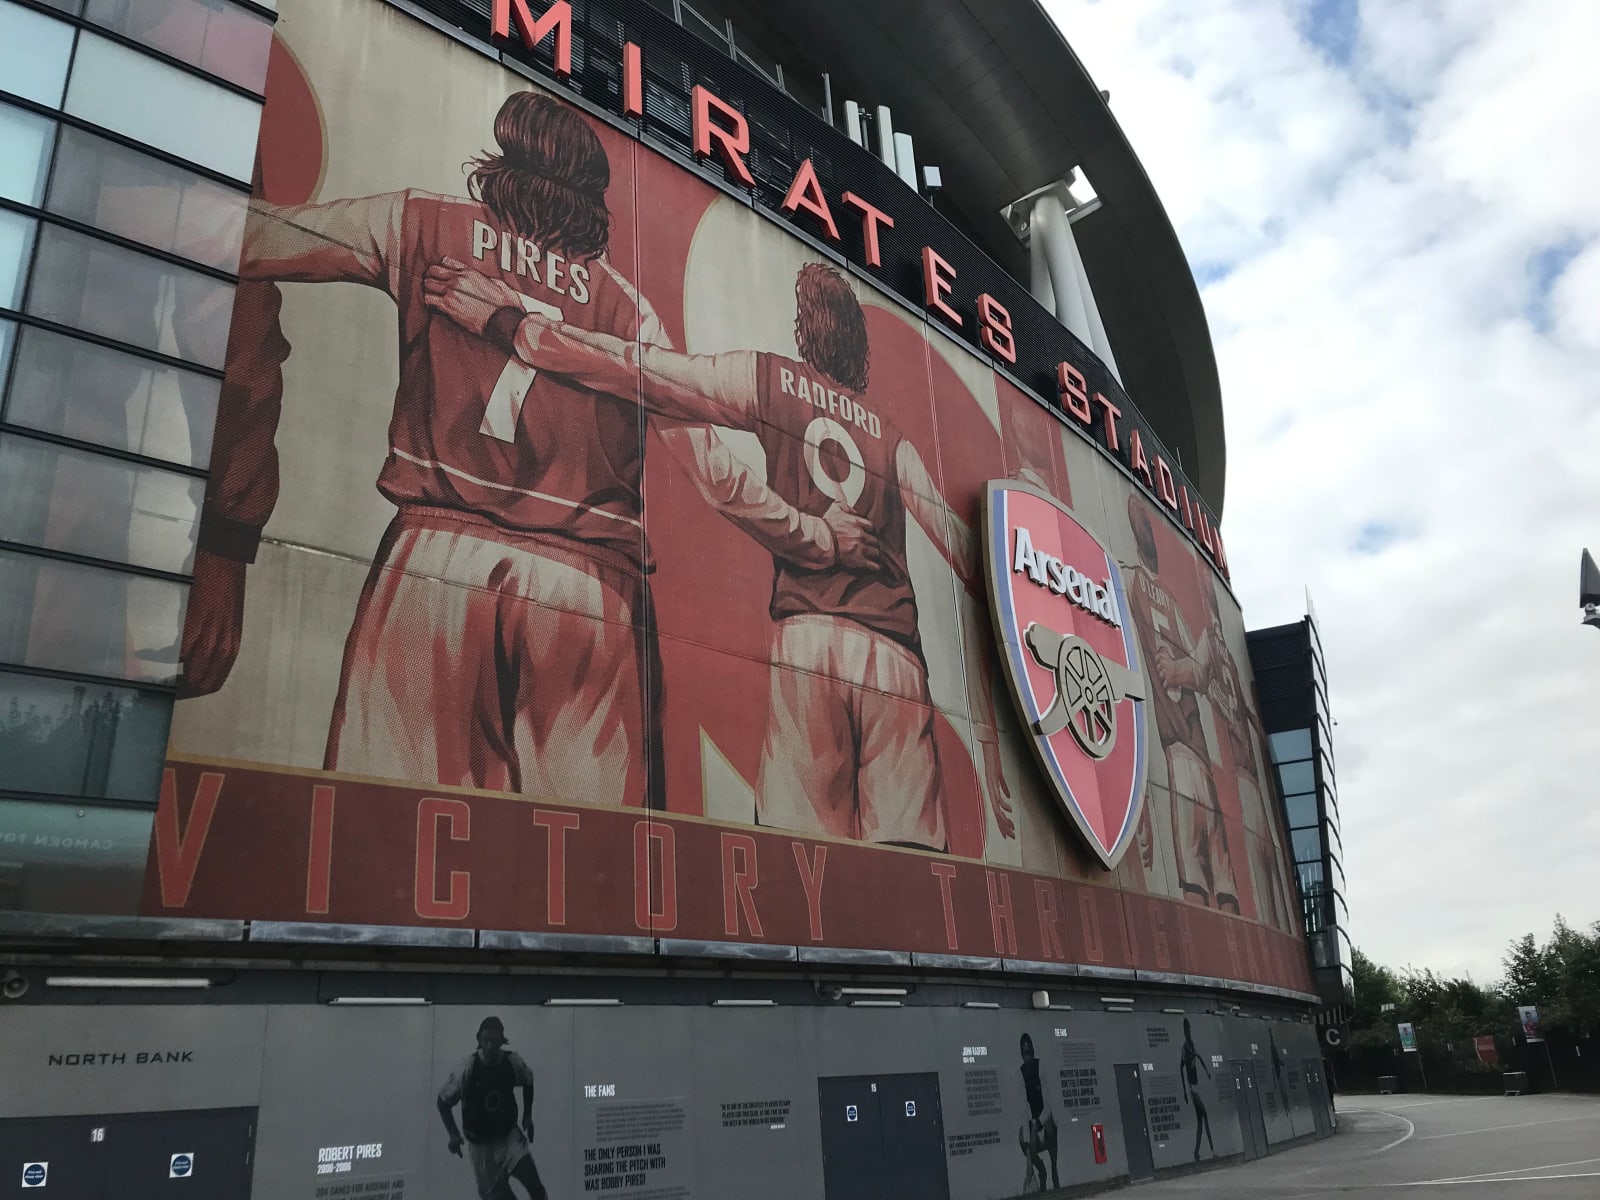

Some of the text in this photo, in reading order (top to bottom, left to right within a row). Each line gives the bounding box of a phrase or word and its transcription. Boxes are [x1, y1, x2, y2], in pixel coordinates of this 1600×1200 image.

[472, 219, 590, 304] PIRES
[780, 367, 882, 439] RADFORD
[1057, 361, 1230, 580] STADIUM
[1014, 526, 1123, 628] Arsenal
[154, 767, 828, 941] VICTORY
[930, 862, 1199, 972] THROUGH
[1325, 1028, 1341, 1046] C
[48, 1050, 194, 1067] NORTH BANK
[584, 1084, 616, 1098] THE FANS
[91, 1128, 105, 1143] 16
[318, 1143, 382, 1163] ROBERT PIRES
[584, 1148, 597, 1162] THE
[598, 1146, 616, 1161] ONLY
[616, 1144, 642, 1159] PERSON
[647, 1143, 661, 1156] WAS
[584, 1156, 666, 1177] SHARING THE PITCH WITH
[584, 1178, 600, 1192] WAS
[601, 1175, 624, 1190] BOBBY
